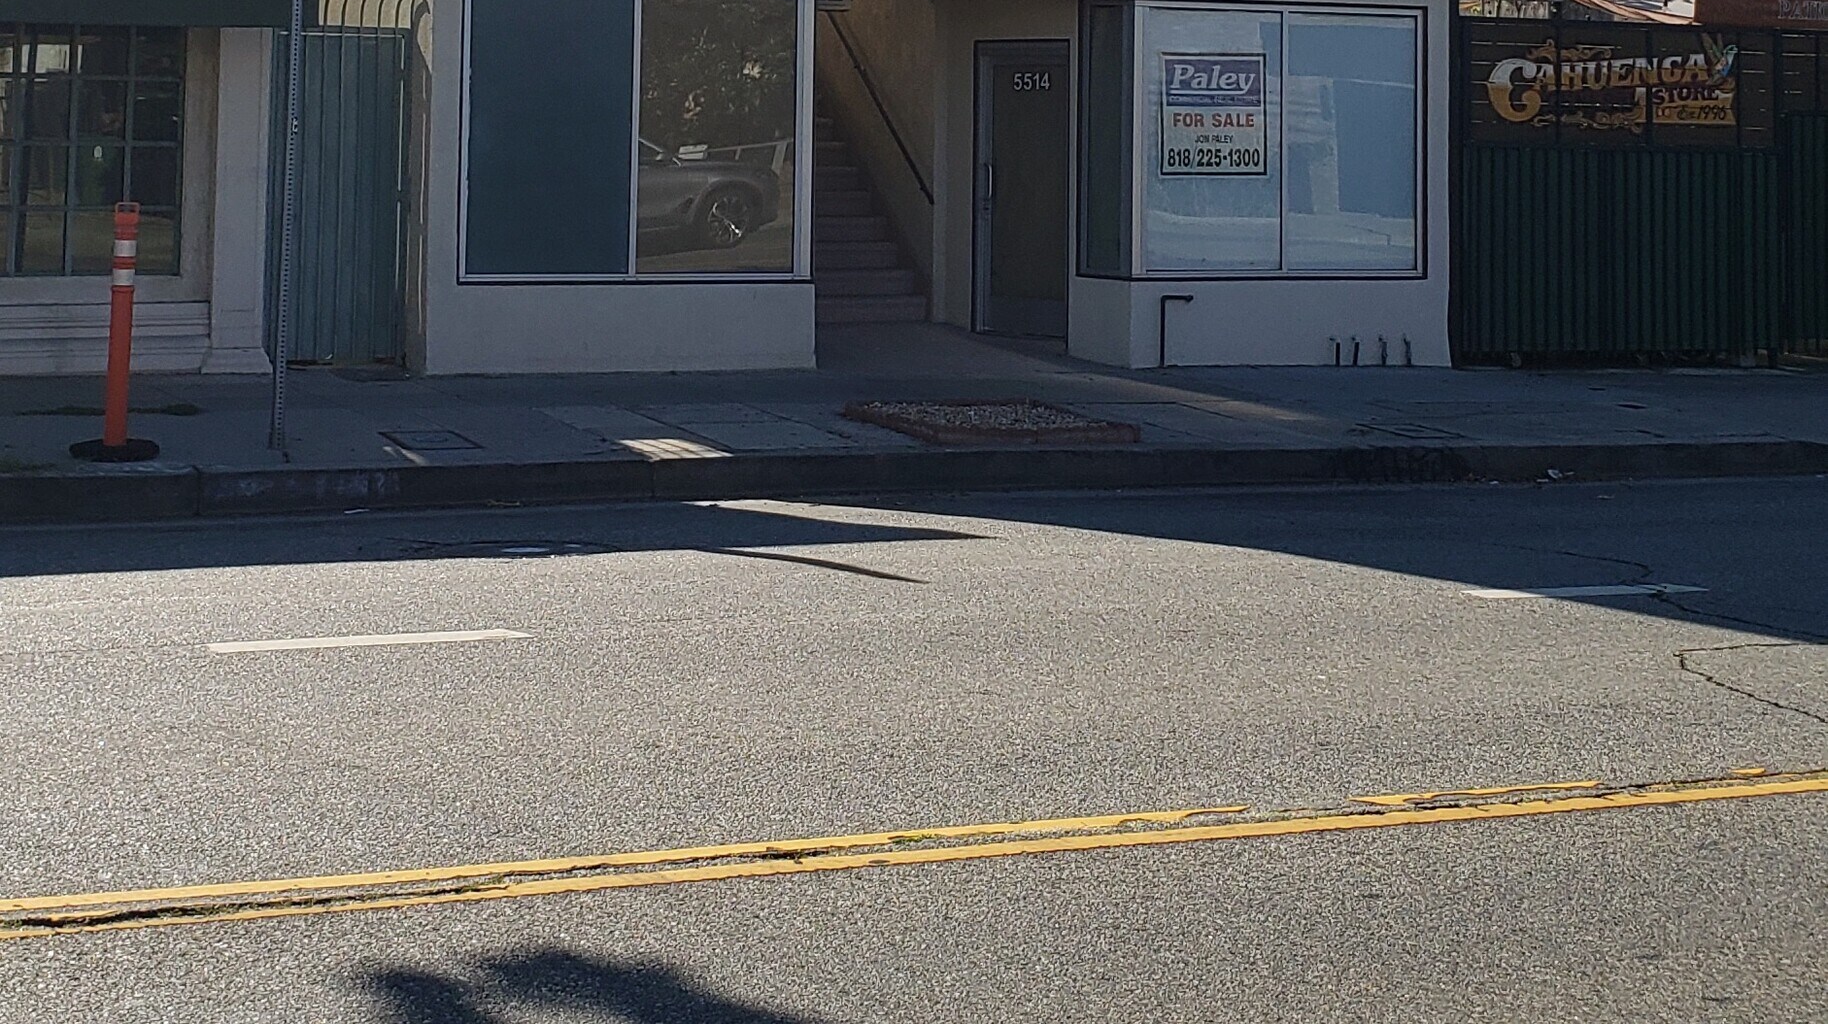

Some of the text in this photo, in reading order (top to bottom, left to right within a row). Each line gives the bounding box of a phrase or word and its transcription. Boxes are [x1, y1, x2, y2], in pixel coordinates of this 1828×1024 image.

[1013, 72, 1050, 91] 5514
[1169, 64, 1256, 95] Paley
[1487, 53, 1711, 122] CAHUENGA
[1652, 87, 1719, 105] STORE
[1172, 112, 1255, 128] FOR SALE
[1211, 134, 1234, 144] PALEY
[1167, 146, 1260, 168] 818/225-1300
